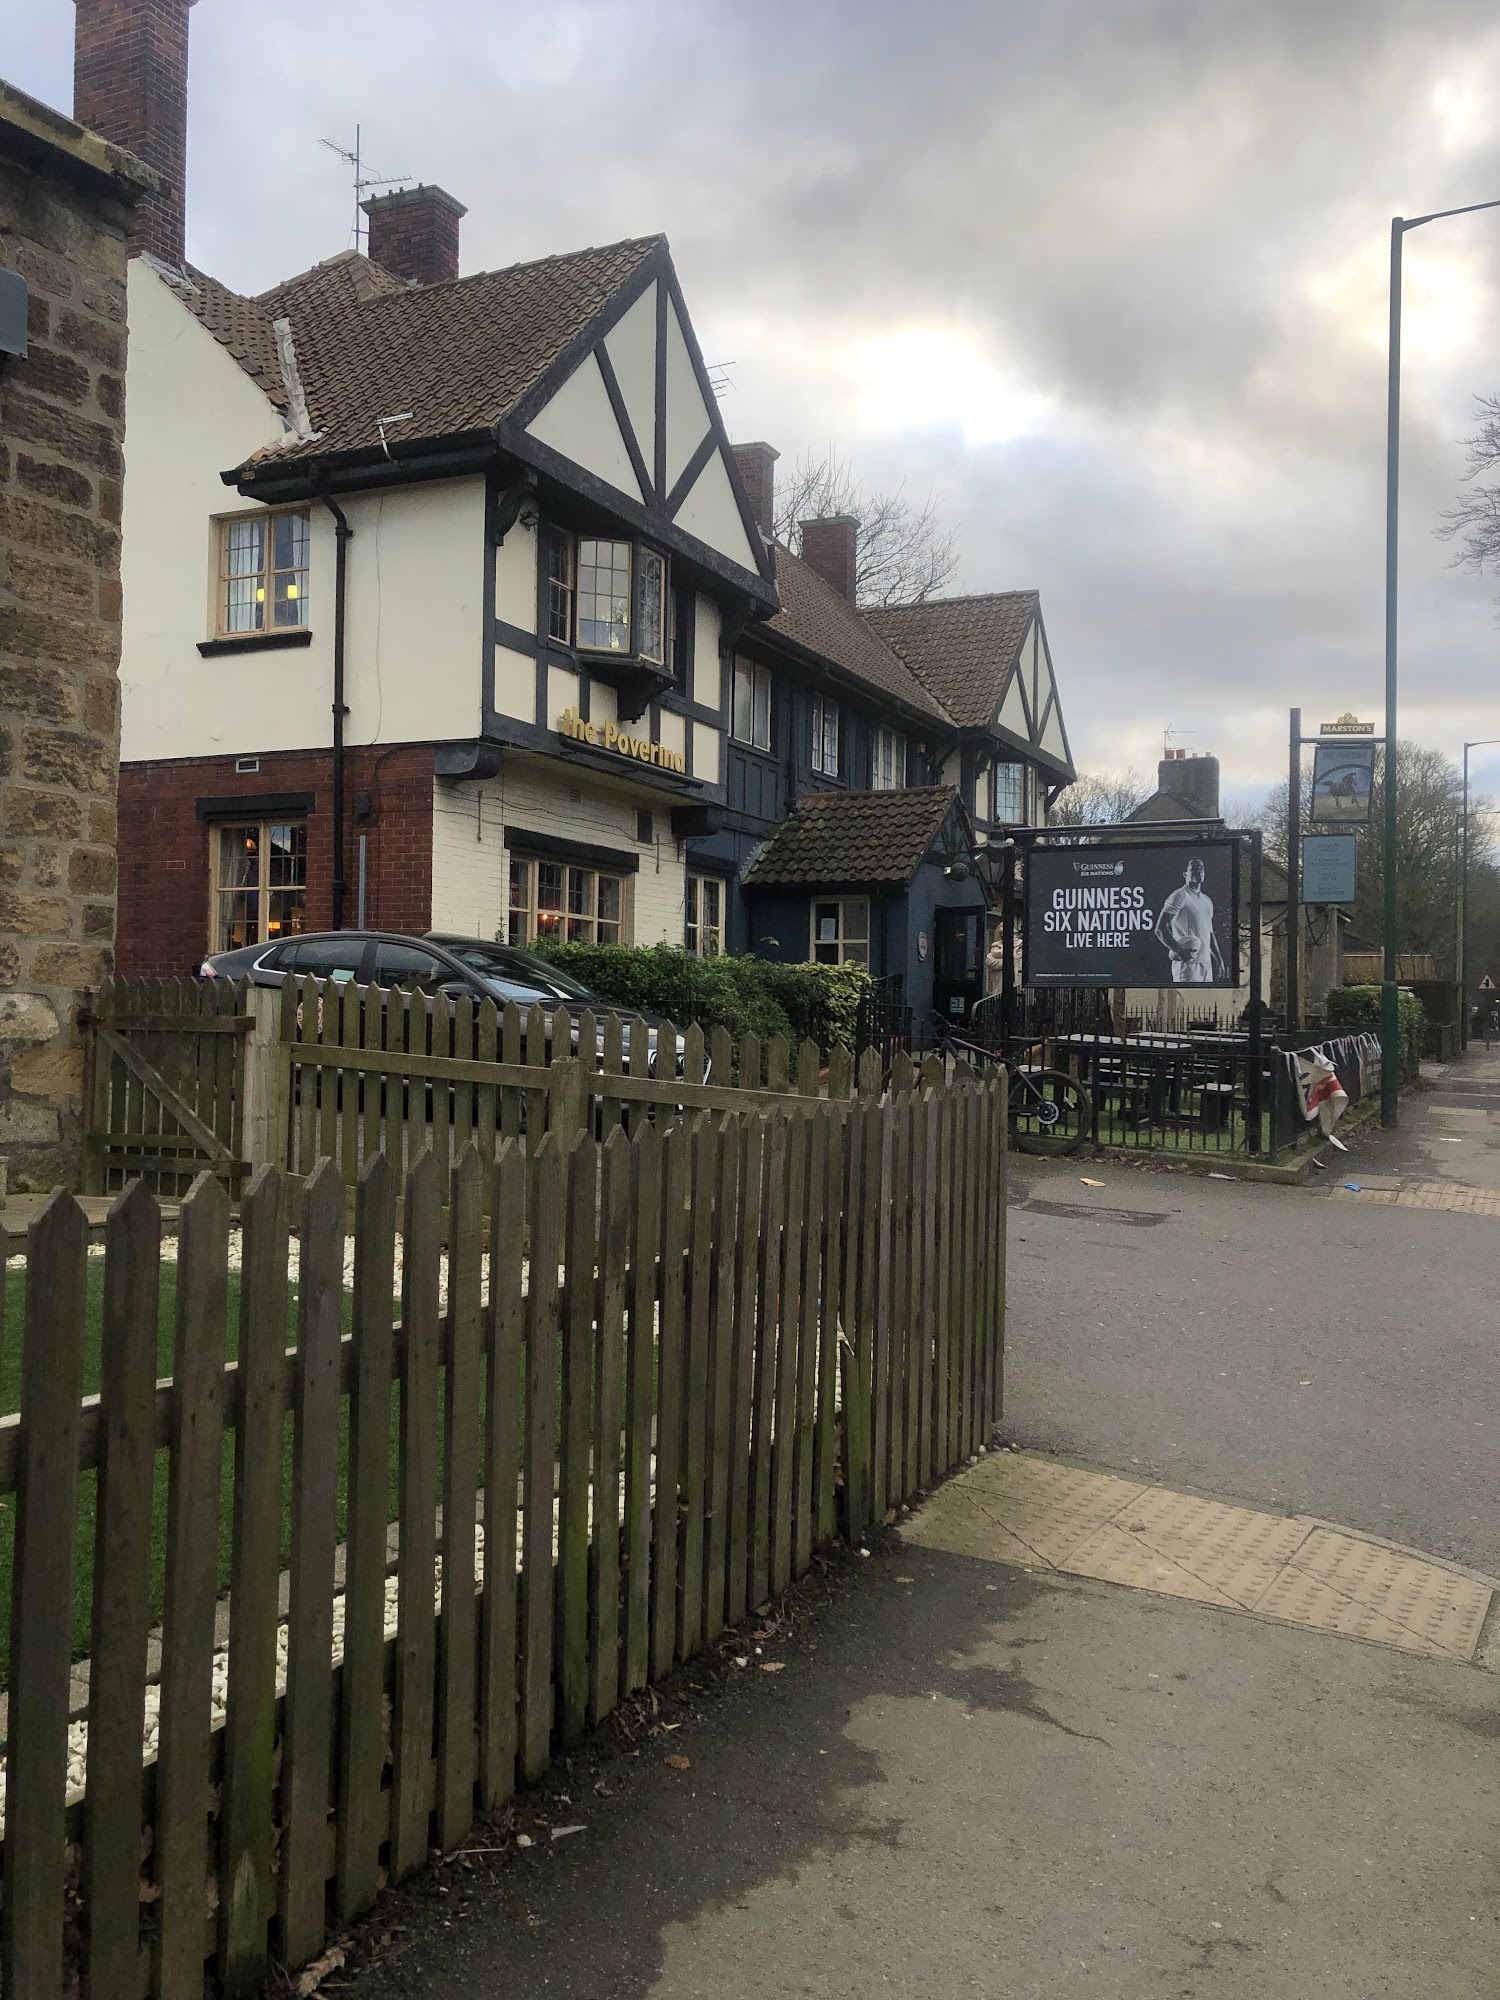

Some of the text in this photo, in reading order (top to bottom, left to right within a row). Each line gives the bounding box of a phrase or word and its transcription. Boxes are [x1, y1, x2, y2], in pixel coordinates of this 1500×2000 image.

[561, 706, 597, 744] the
[1052, 886, 1144, 910] GUINNESS
[1043, 909, 1153, 932] SIX NATIONS
[1065, 932, 1130, 949] LIVE HERE
